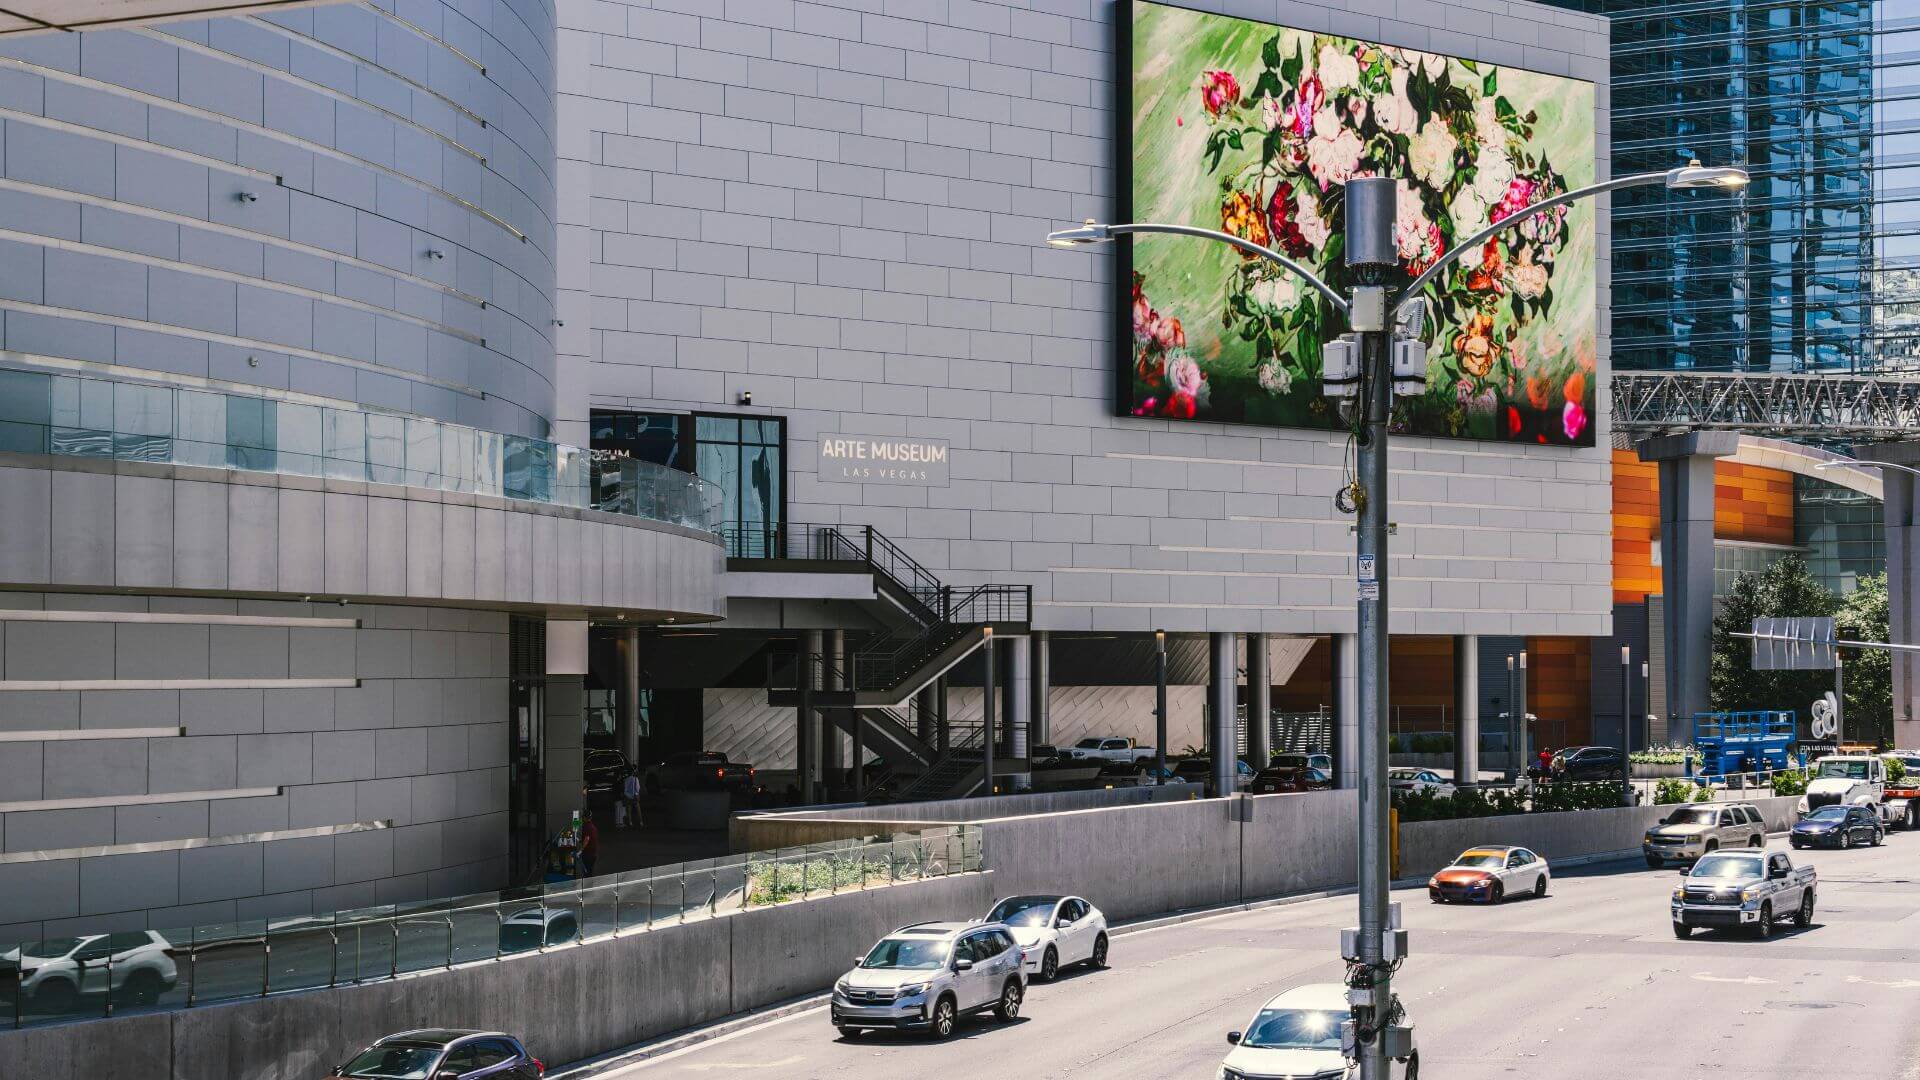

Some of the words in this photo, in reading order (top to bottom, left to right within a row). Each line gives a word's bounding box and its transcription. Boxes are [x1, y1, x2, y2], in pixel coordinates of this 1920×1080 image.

[822, 439, 867, 459] ARTE
[871, 442, 947, 463] MUSEUM
[843, 467, 870, 478] LAS
[879, 469, 928, 480] VEGAS
